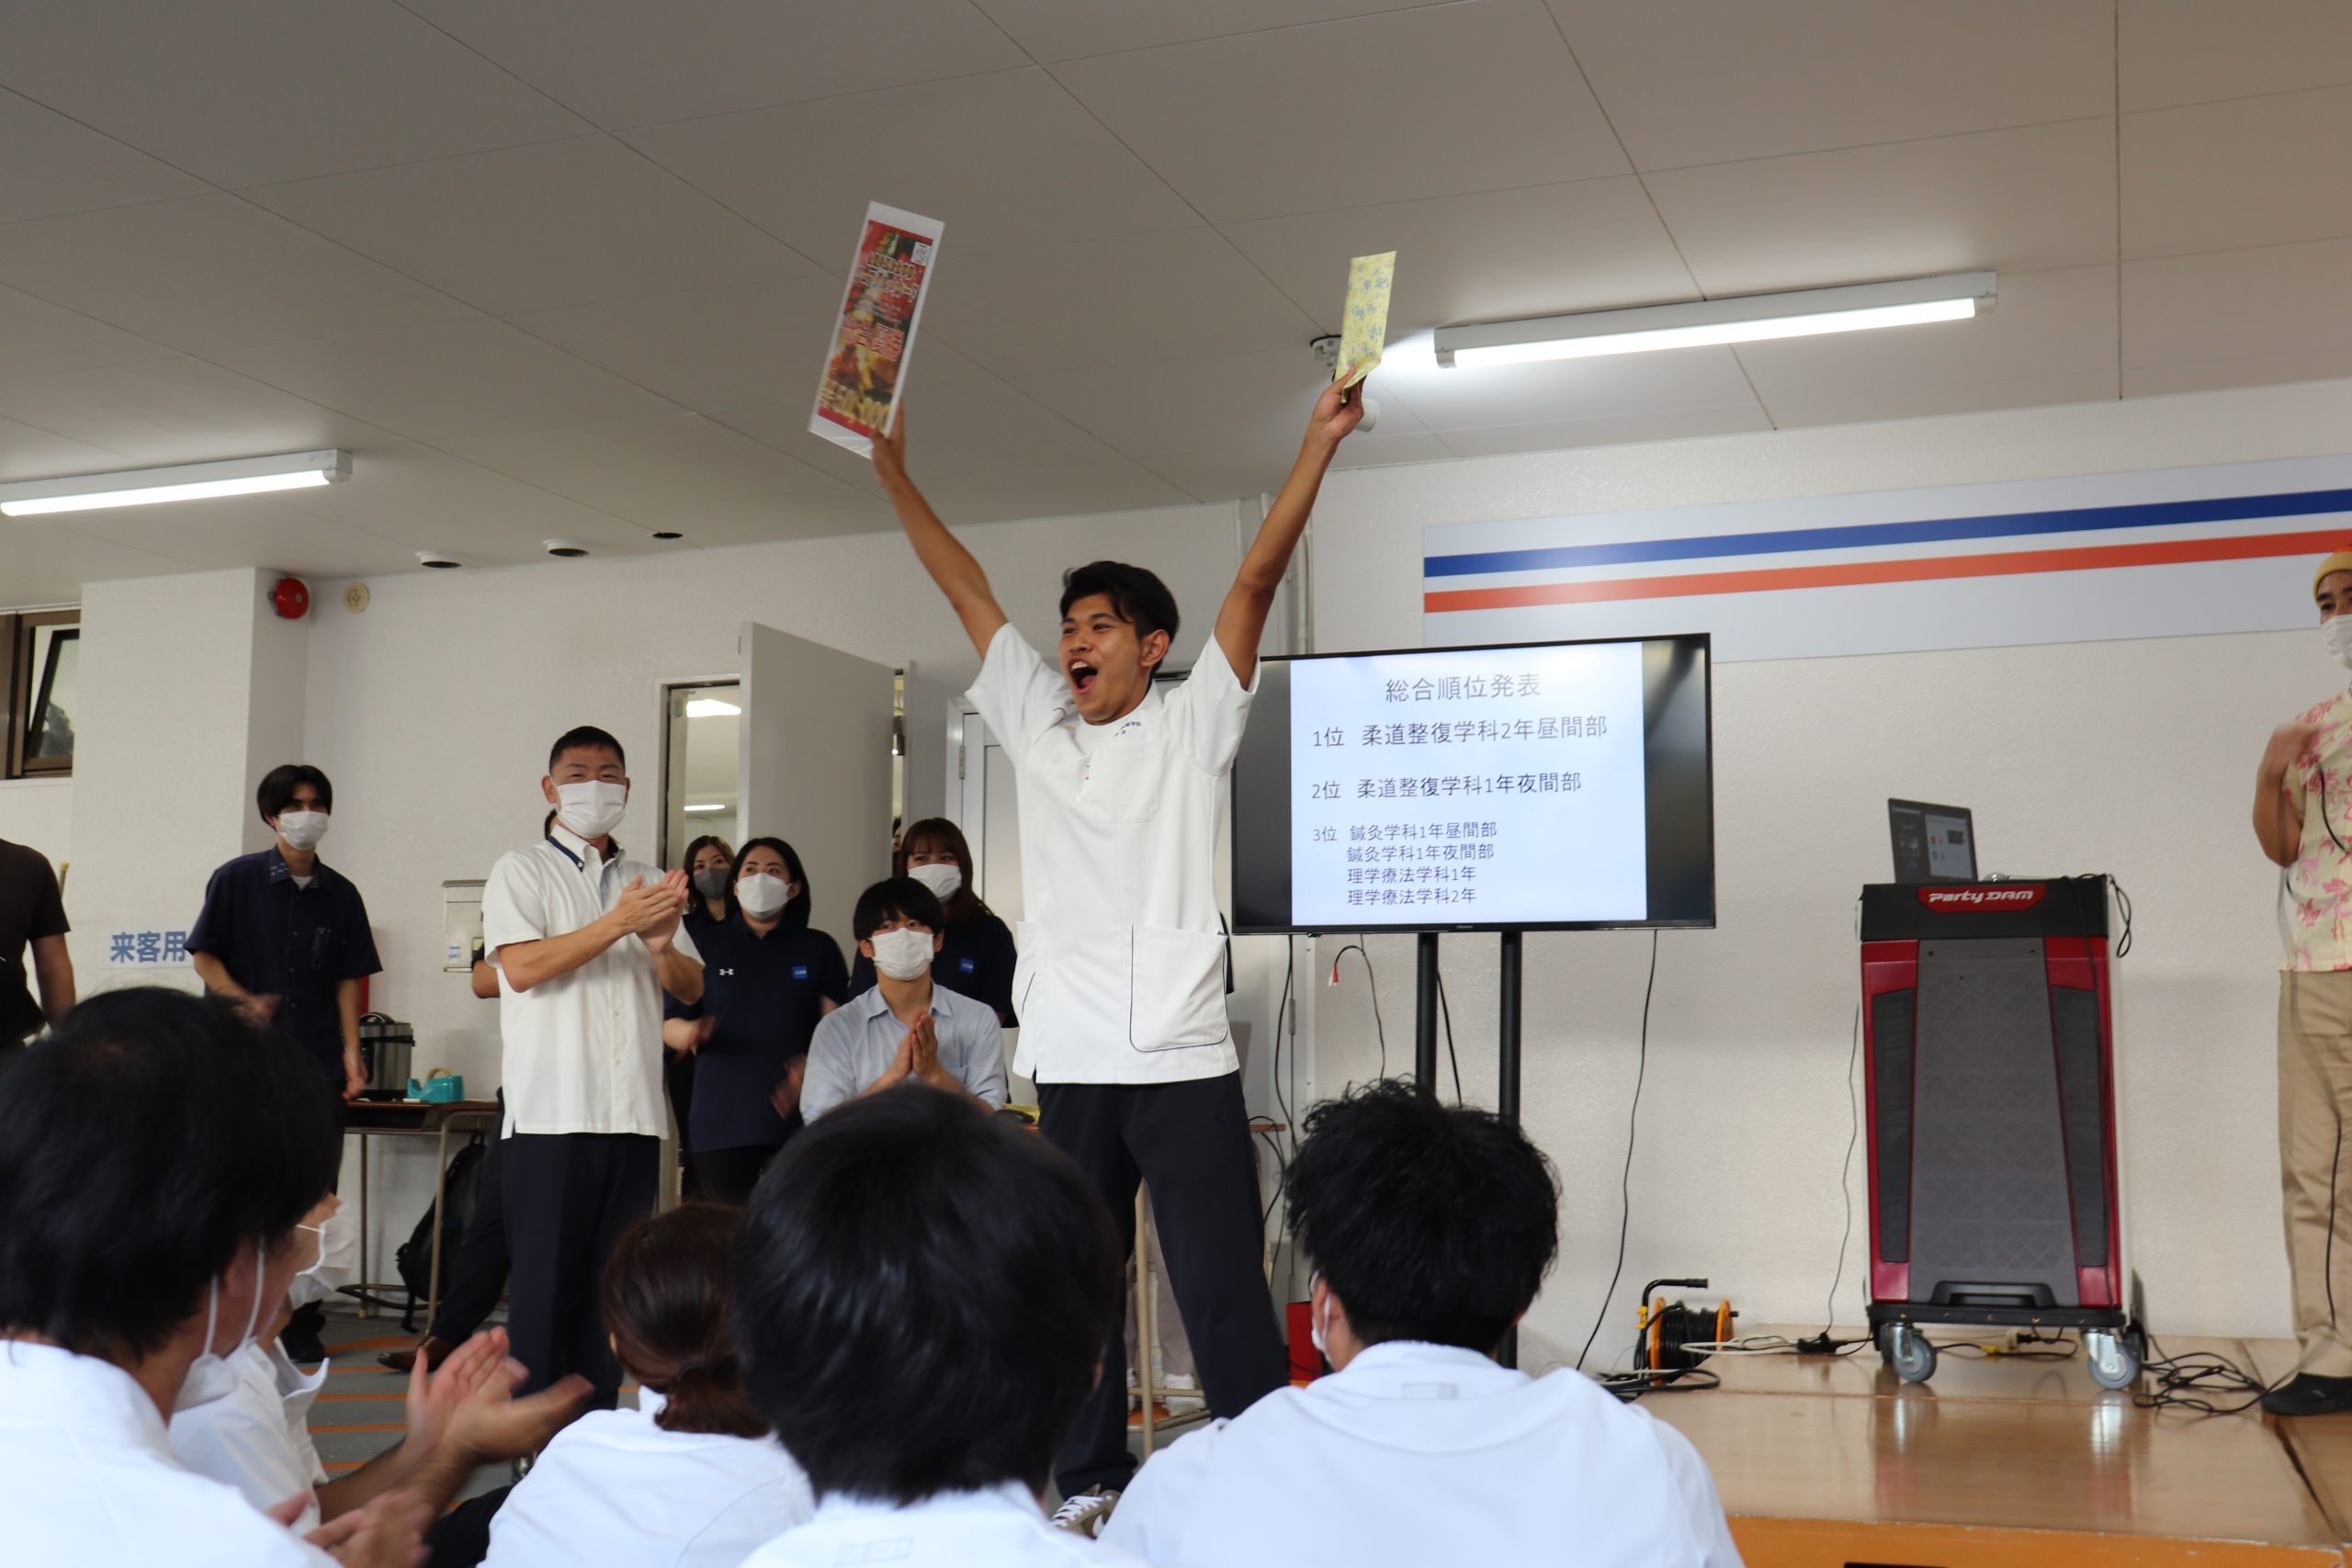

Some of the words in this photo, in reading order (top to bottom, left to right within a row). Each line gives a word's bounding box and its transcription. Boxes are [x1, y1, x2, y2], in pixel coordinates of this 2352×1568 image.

[1385, 672, 1541, 703] 総合順位発表
[1313, 726, 1344, 748] 1位
[1362, 716, 1608, 746] 柔道整復学科2年昼間部
[1311, 780, 1341, 800] 2位
[1357, 771, 1581, 799] 柔道整復学科1年夜間部
[1312, 826, 1338, 842] 3位
[1350, 821, 1498, 841] 鍼灸学科1年昼間部
[1347, 843, 1494, 863] 鍼灸学科1年夜間部
[1347, 865, 1476, 884] 理学療法学科1年
[1347, 887, 1476, 906] 理学療法学科2年
[1928, 890, 1984, 904] Party
[1985, 890, 2034, 900] DAM
[110, 931, 187, 963] 来客用
